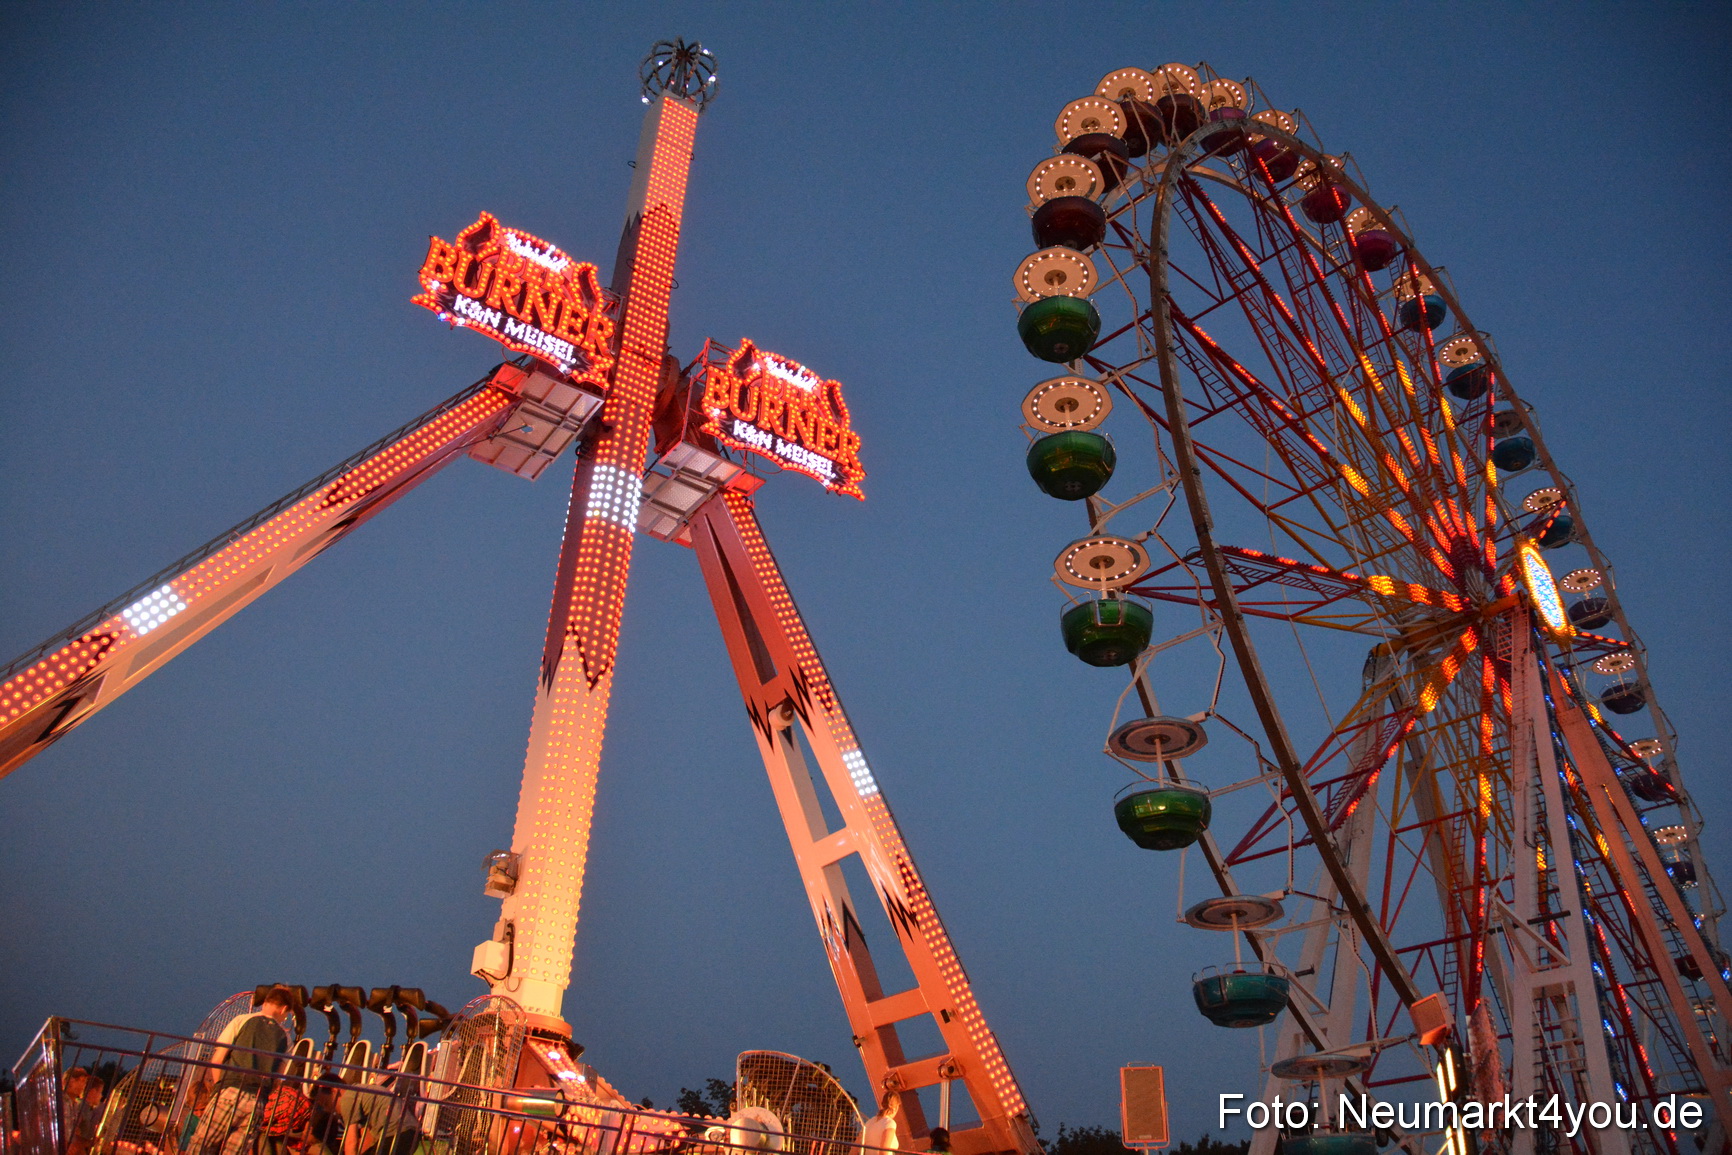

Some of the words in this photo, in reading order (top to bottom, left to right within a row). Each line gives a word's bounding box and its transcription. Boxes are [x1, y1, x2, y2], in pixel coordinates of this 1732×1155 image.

[419, 235, 615, 363] BURNER
[504, 317, 577, 364] MEISEL
[702, 366, 866, 476] BURNER
[775, 438, 836, 479] MEISEL
